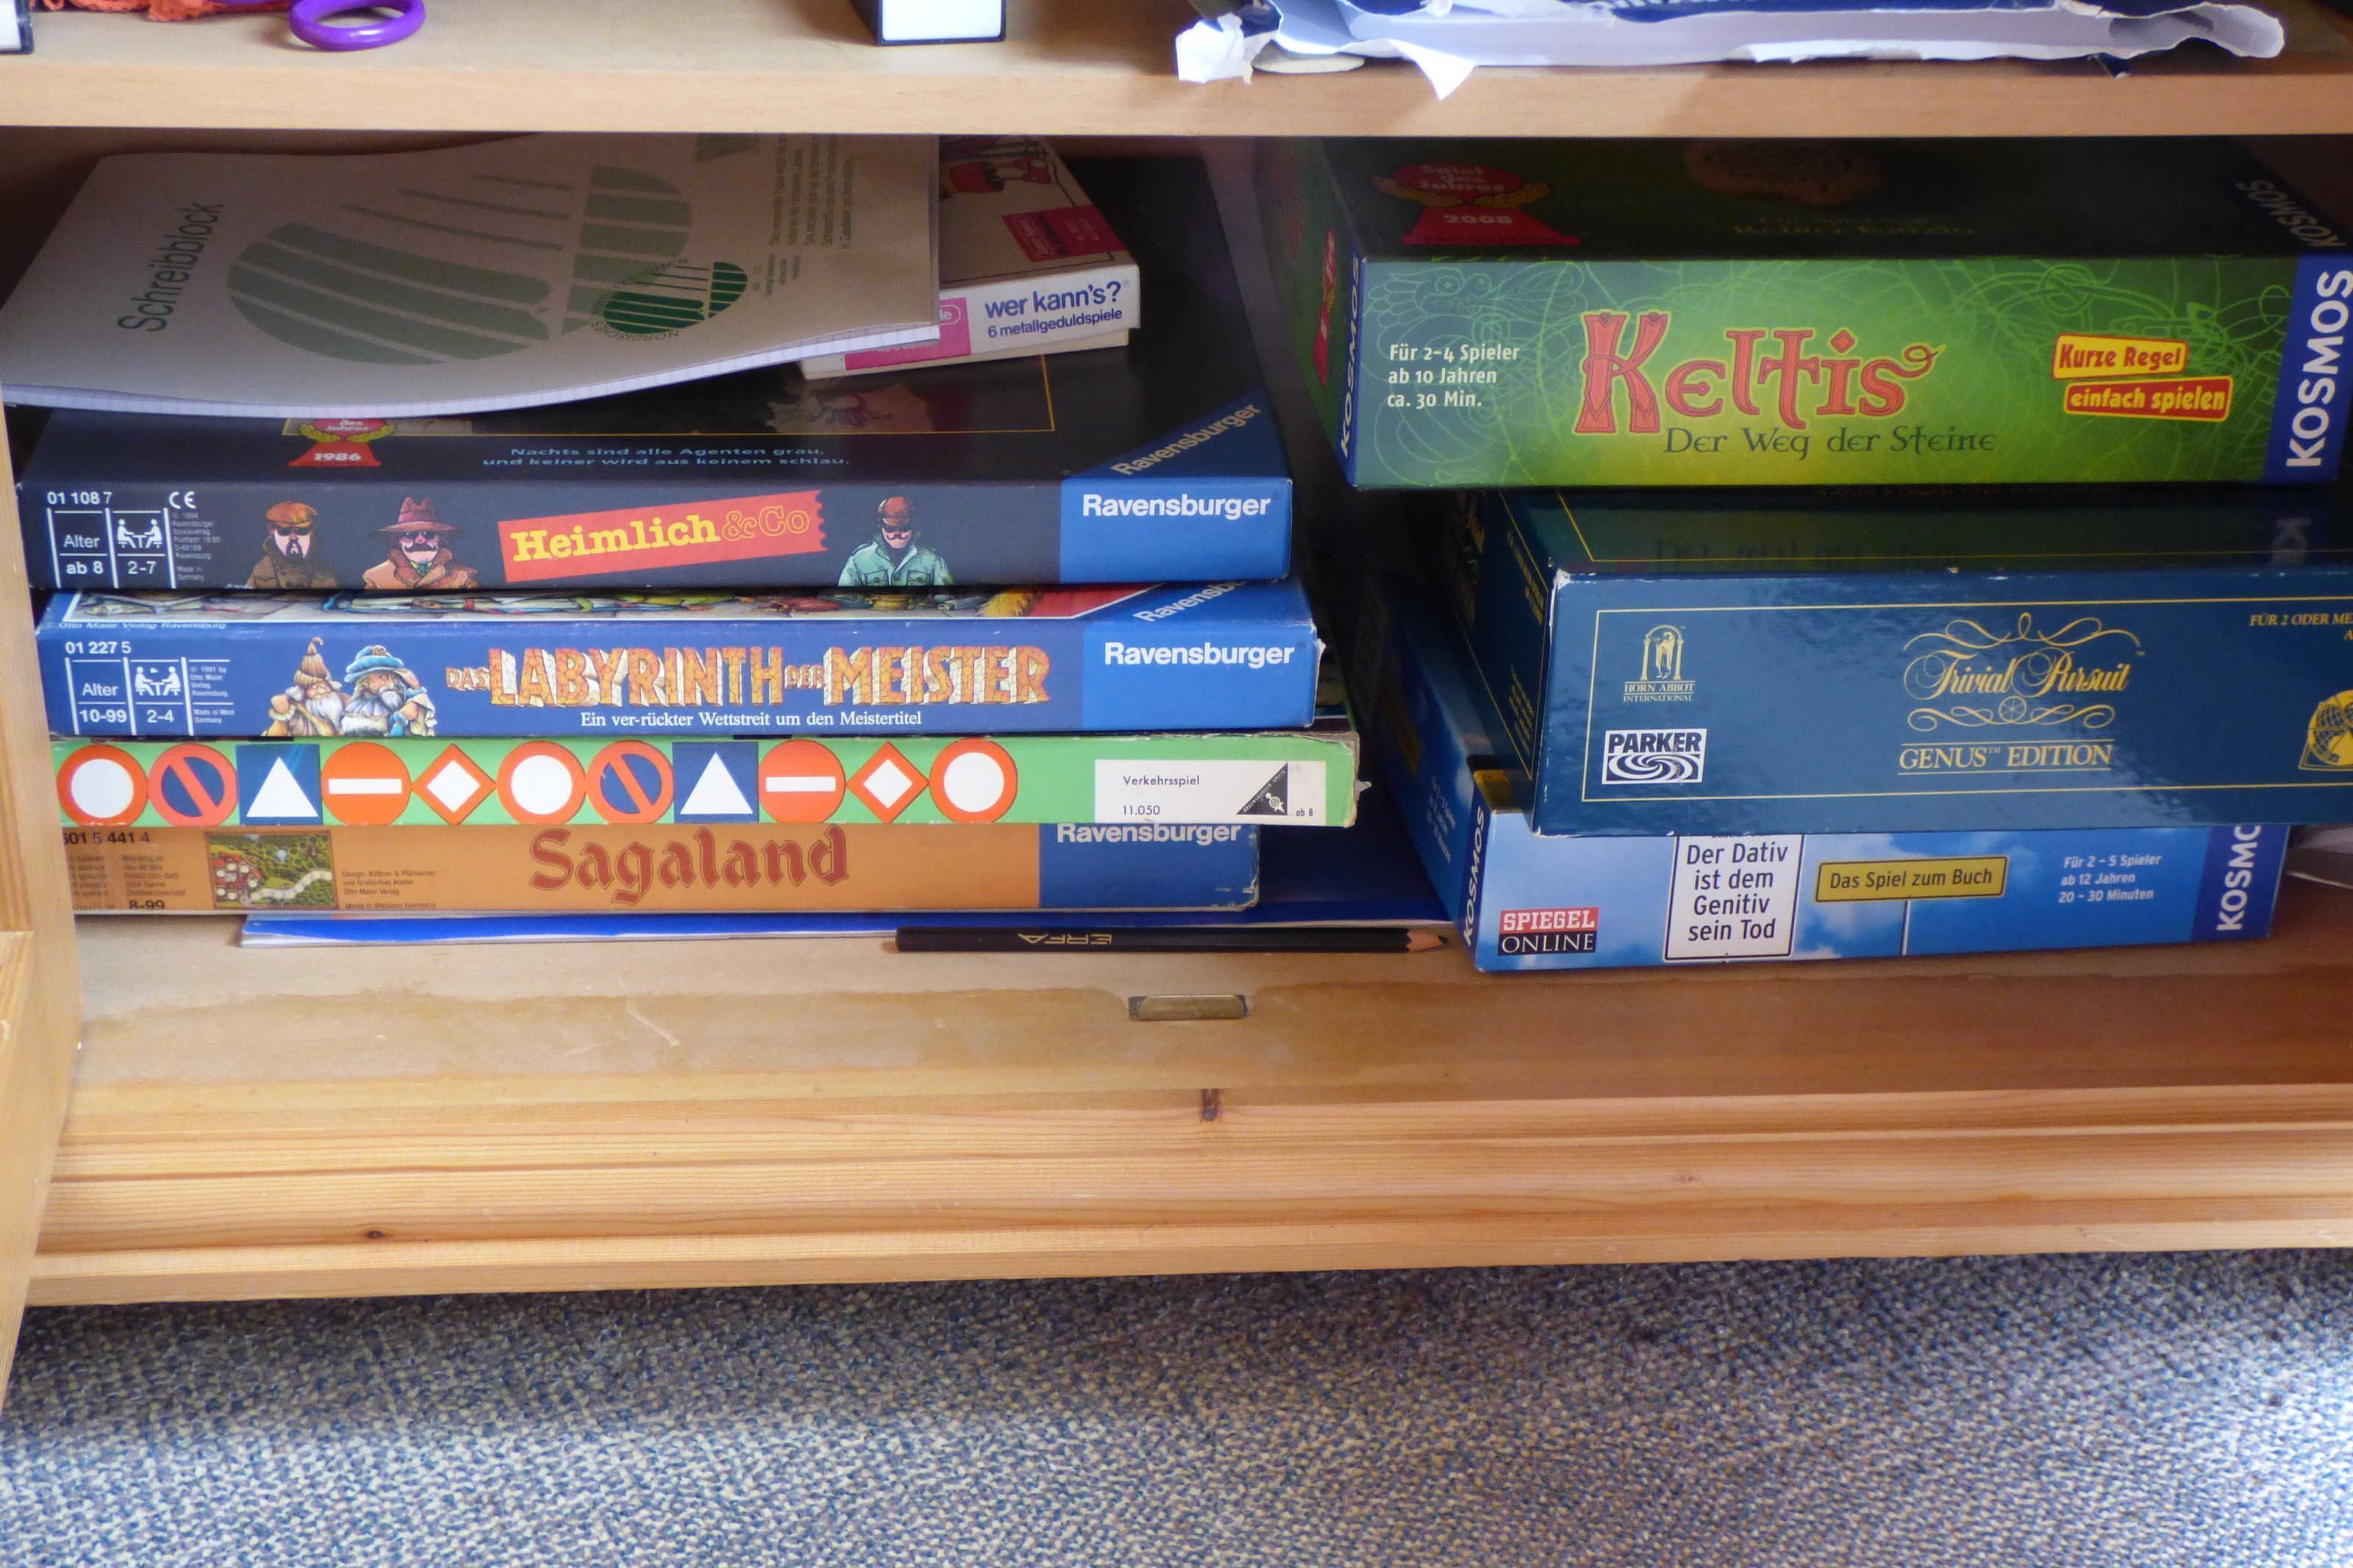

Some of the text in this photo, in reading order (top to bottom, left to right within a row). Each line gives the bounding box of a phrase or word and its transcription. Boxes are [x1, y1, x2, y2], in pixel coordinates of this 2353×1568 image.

[1443, 214, 1514, 224] 2008
[2236, 179, 2348, 247] KOSMOS
[118, 201, 224, 332] Schreibblock
[985, 281, 1121, 318] wer kann's?
[988, 308, 1123, 338] 6 metallgeduldspiele
[1390, 343, 1520, 364] Für 2-4 Spieler
[2060, 344, 2181, 370] Kurze Regel
[1388, 368, 1497, 384] ab 10 Jahren
[1574, 309, 1946, 434] Keltis
[2286, 270, 2353, 467] KOSMOS
[1388, 390, 1482, 409] ca. 30 Min.
[2071, 386, 2225, 413] einfach spielen
[1110, 404, 1261, 475] Ravensburger
[1664, 426, 1997, 460] Der Weg der Steine
[315, 451, 361, 461] 1986
[510, 448, 579, 456] Nachts
[586, 448, 629, 456] sind
[635, 448, 673, 456] alle
[679, 448, 765, 457] Agenten
[47, 491, 66, 504] 01
[71, 491, 100, 504] 108
[1082, 494, 1271, 520] Ravensburger
[64, 534, 100, 548] Alter
[510, 515, 720, 562] Heimlich
[66, 561, 104, 574] ab 8
[127, 561, 157, 574] 2-7
[1132, 581, 1246, 622] Ravensb
[2249, 612, 2279, 626] FÜR
[2281, 614, 2290, 626] 2
[2291, 613, 2329, 625] ODER
[65, 641, 131, 654] 01 227 5
[1104, 642, 1294, 669] Ravensburger
[446, 645, 1051, 707] DAS LABYRINTH DER MEISTER
[1904, 647, 2131, 701] Trivial Pursuit
[82, 683, 118, 696] Alter
[1624, 683, 1696, 692] HORN ABBOT
[1624, 694, 1694, 703] INTERNATIONAL
[79, 709, 127, 723] 10-99
[147, 709, 174, 723] 2-4
[581, 710, 922, 727] Ein ver-rückter Wettstreit um den Meistertitel
[1608, 732, 1702, 753] PARKER
[2007, 744, 2113, 767] EDITION
[1123, 776, 1200, 789] Verkehrsspiel
[1123, 806, 1160, 816] 11.050
[1296, 809, 1307, 817] ab
[1057, 823, 1241, 845] Ravensburger
[1687, 842, 1788, 864] Der Dativ
[2064, 856, 2085, 869] Für
[2086, 856, 2096, 867] 2
[2108, 855, 2117, 867] 5
[2120, 854, 2162, 868] Spieler
[529, 826, 849, 906] Sagaland
[1463, 806, 1485, 945] KOSMOS
[1694, 869, 1774, 890] ist dem
[1830, 868, 1993, 891] Das Spiel zum Buch
[2061, 873, 2135, 887] ab 12 Jahren
[2216, 825, 2262, 931] KOSMO
[1693, 895, 1770, 915] Genitiv
[2059, 892, 2074, 903] 20
[2087, 890, 2103, 902] 30
[2107, 889, 2154, 901] Minuten
[1503, 909, 1595, 932] SPIEGEL
[1688, 919, 1775, 942] sein Tod
[1018, 934, 1113, 945] ERFA
[1502, 933, 1593, 953] ONLINE
